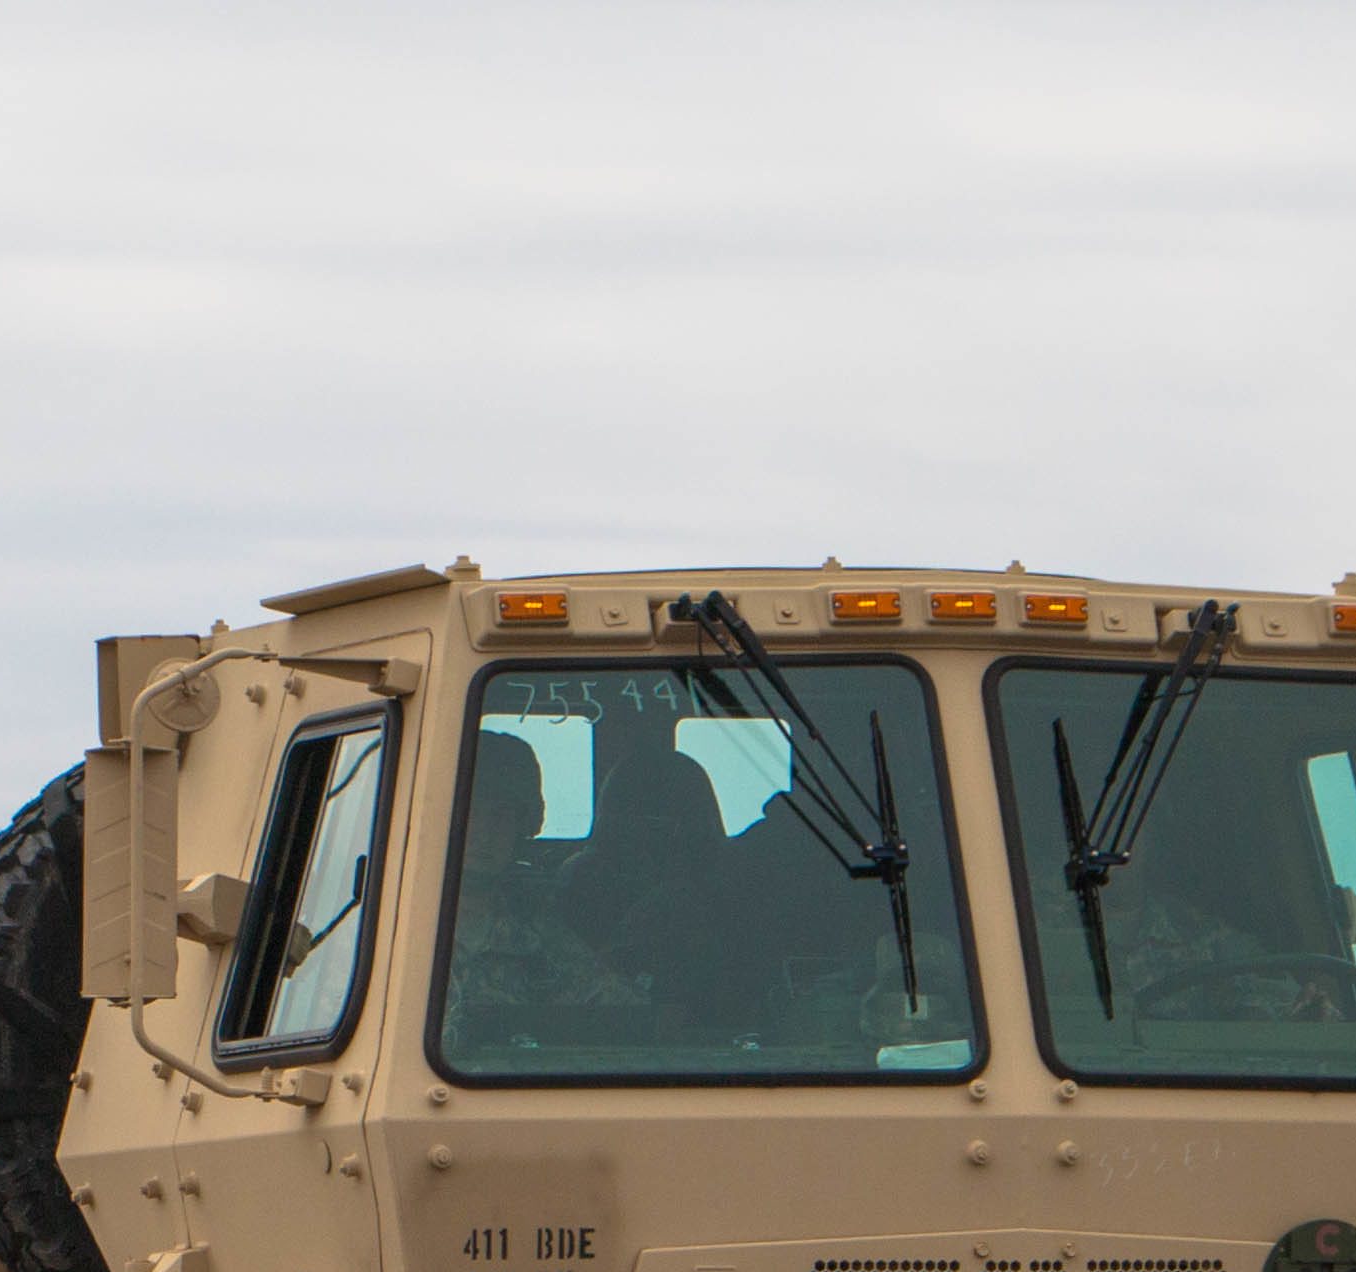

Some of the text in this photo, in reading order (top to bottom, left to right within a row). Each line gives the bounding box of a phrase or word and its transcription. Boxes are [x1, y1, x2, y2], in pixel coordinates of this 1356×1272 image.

[506, 681, 603, 725] 755
[463, 1227, 596, 1260] 411 BDE
[1315, 1224, 1340, 1257] C
